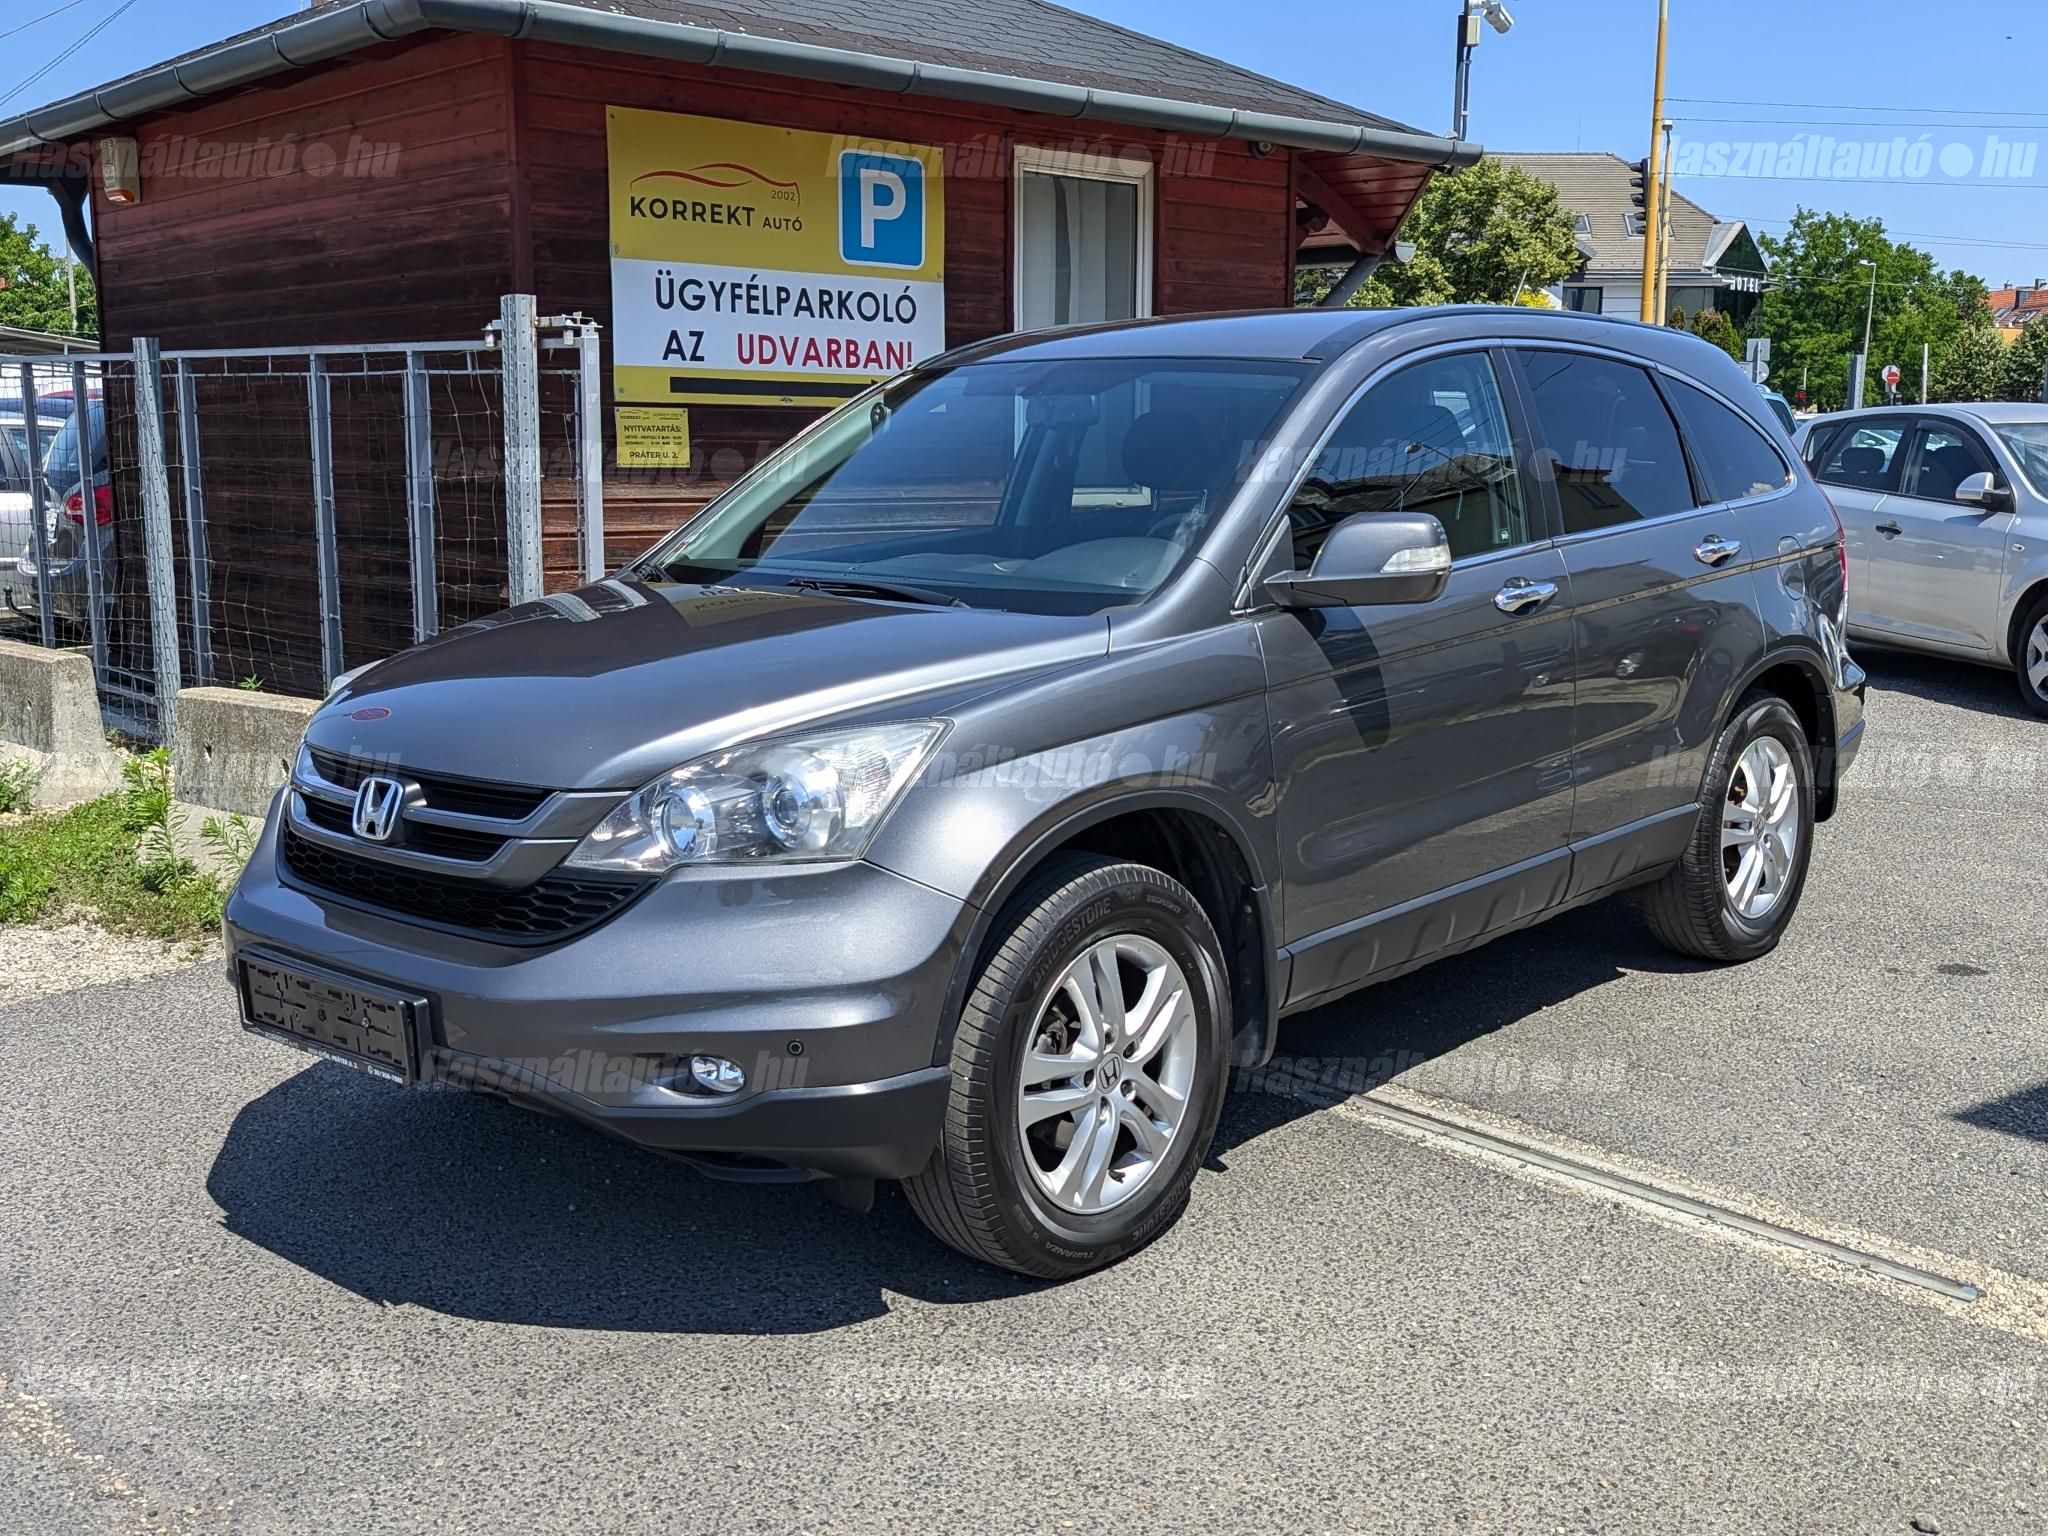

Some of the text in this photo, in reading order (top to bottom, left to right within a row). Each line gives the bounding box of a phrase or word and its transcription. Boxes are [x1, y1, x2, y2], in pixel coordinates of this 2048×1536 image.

[771, 189, 796, 201] 2002
[860, 168, 907, 248] P
[630, 196, 803, 232] KORREKT AUTÓ
[655, 269, 917, 324] ÜGYFÉLPARKOLÓ
[662, 330, 912, 371] AZ UDVARBAN!
[624, 424, 682, 433] NYITVATARTÁS:
[629, 450, 661, 459] PRÁTER
